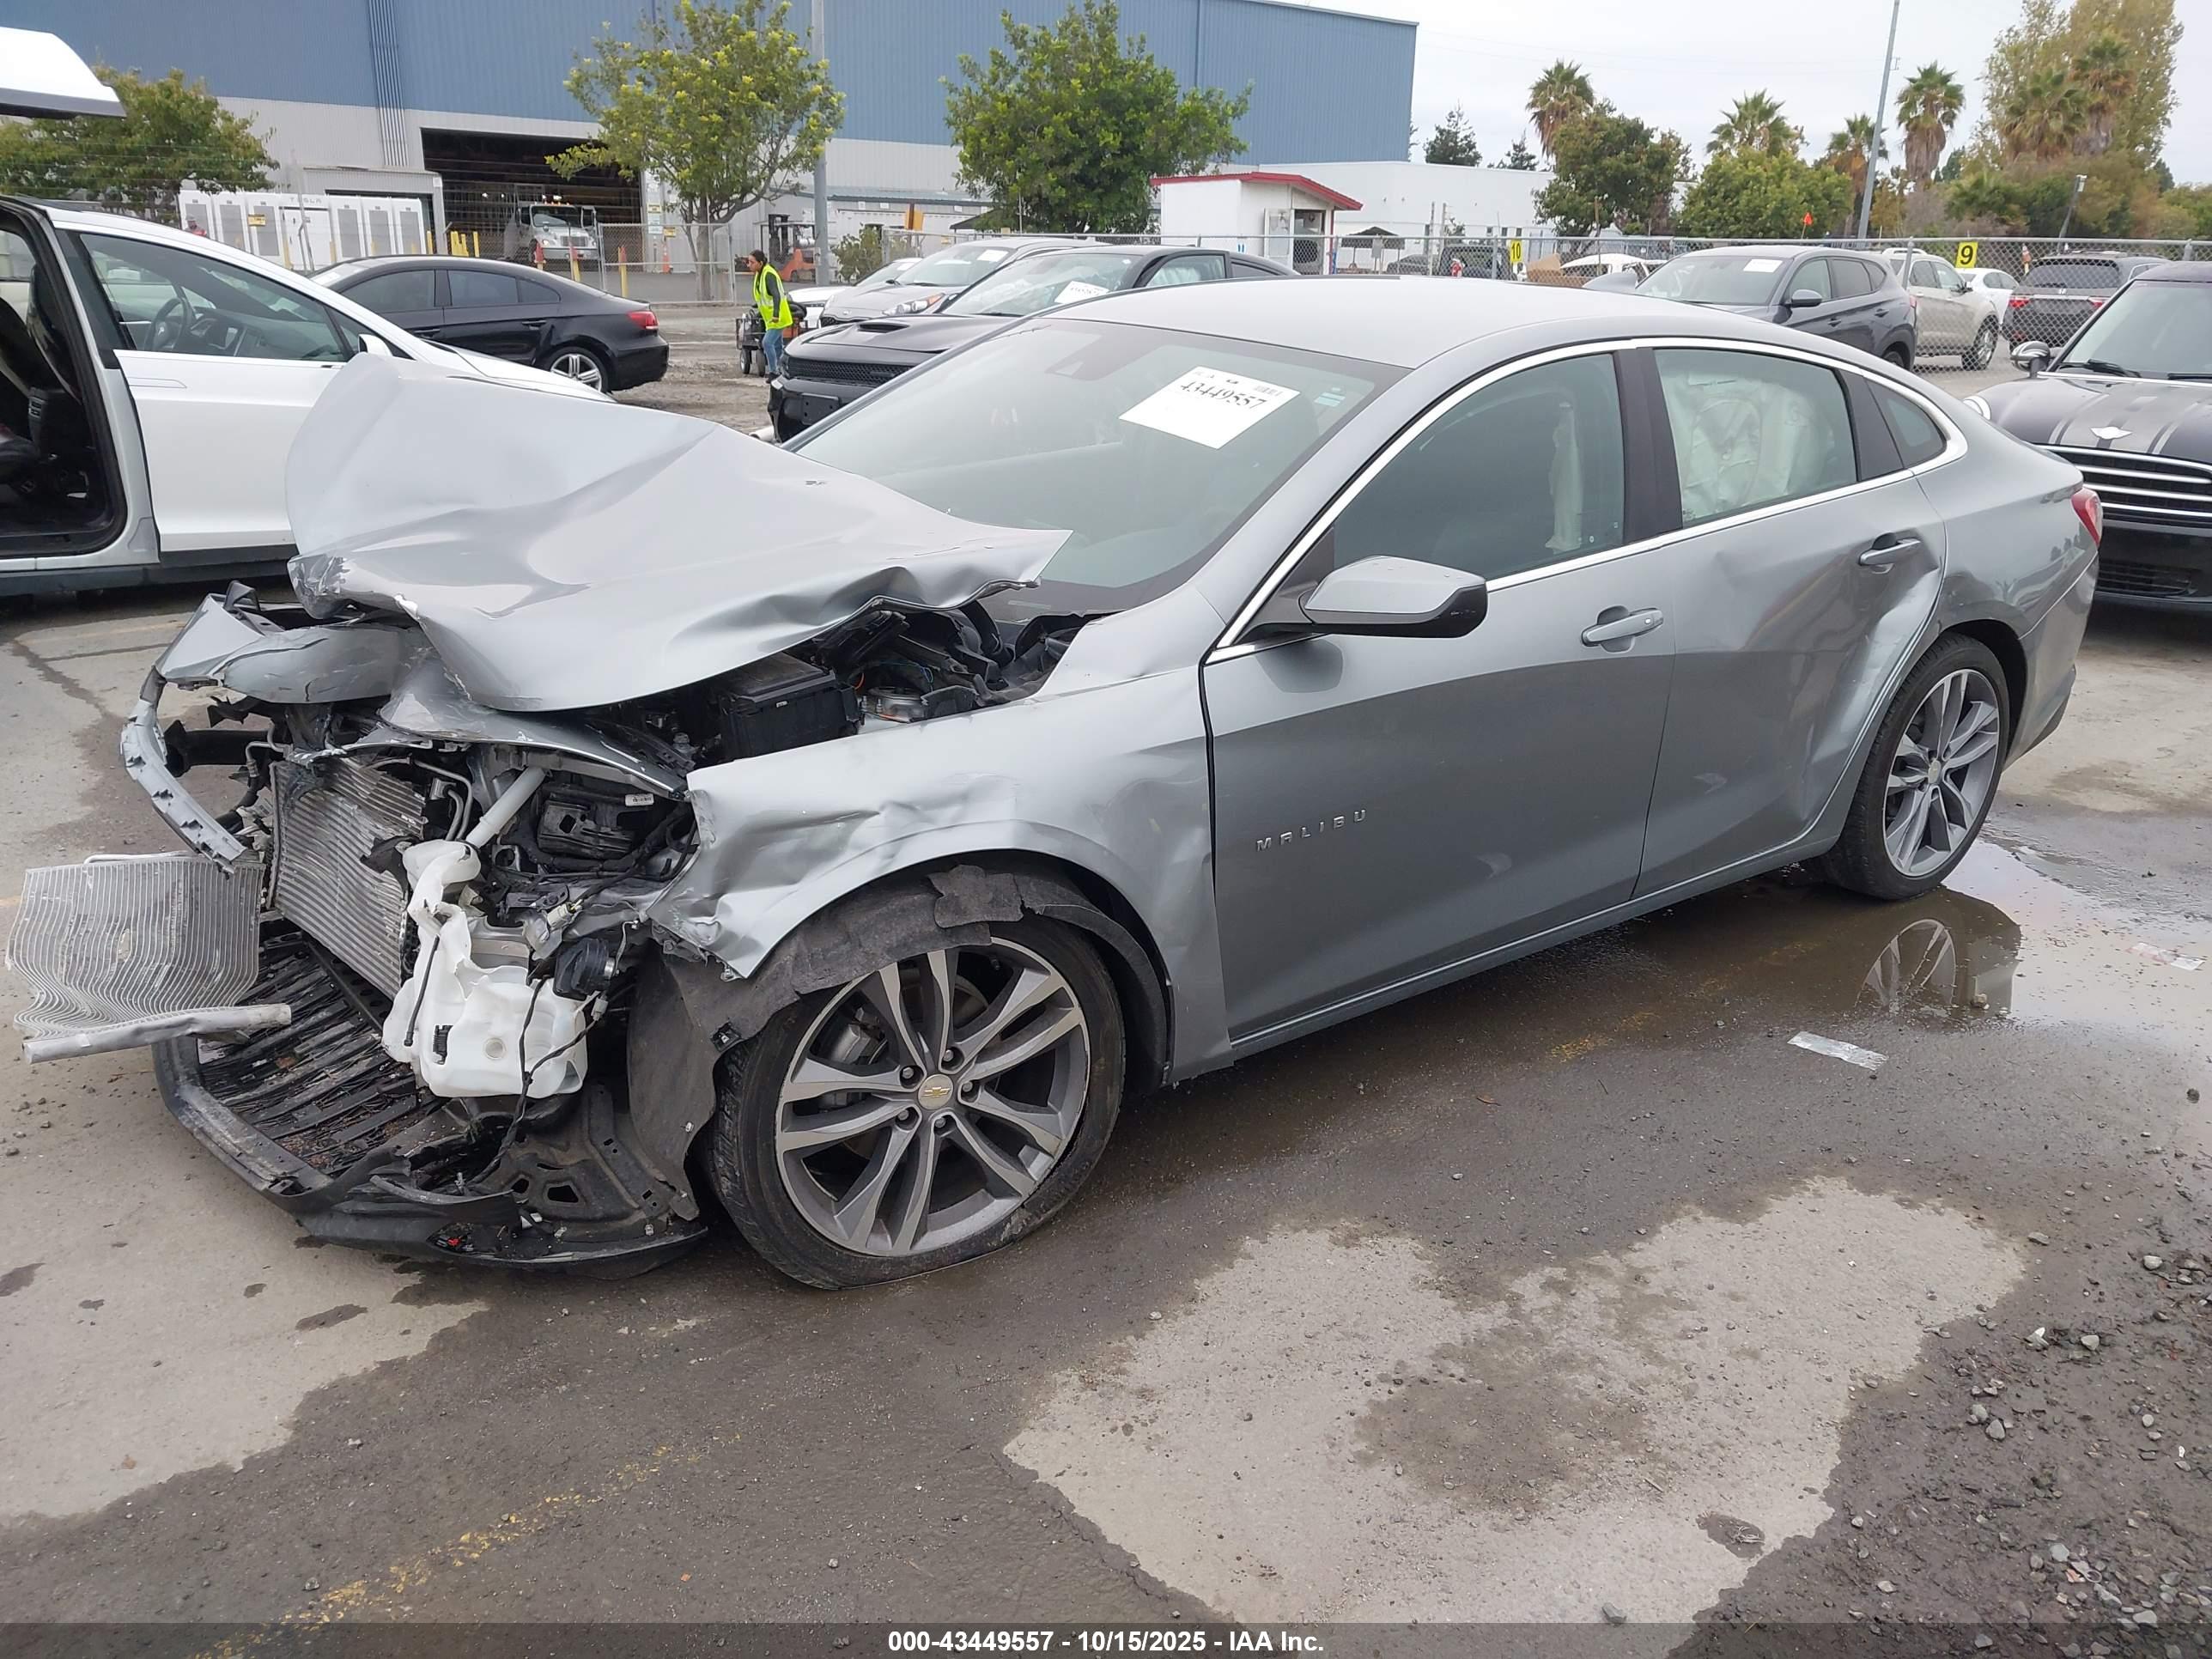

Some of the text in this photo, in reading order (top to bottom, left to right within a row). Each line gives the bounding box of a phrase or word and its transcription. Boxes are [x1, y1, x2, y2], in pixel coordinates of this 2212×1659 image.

[289, 196, 323, 204] TSLA
[1511, 242, 1522, 259] 10
[1960, 245, 1974, 265] 9
[1180, 380, 1268, 410] 43449557
[1256, 809, 1366, 852] MALIBU
